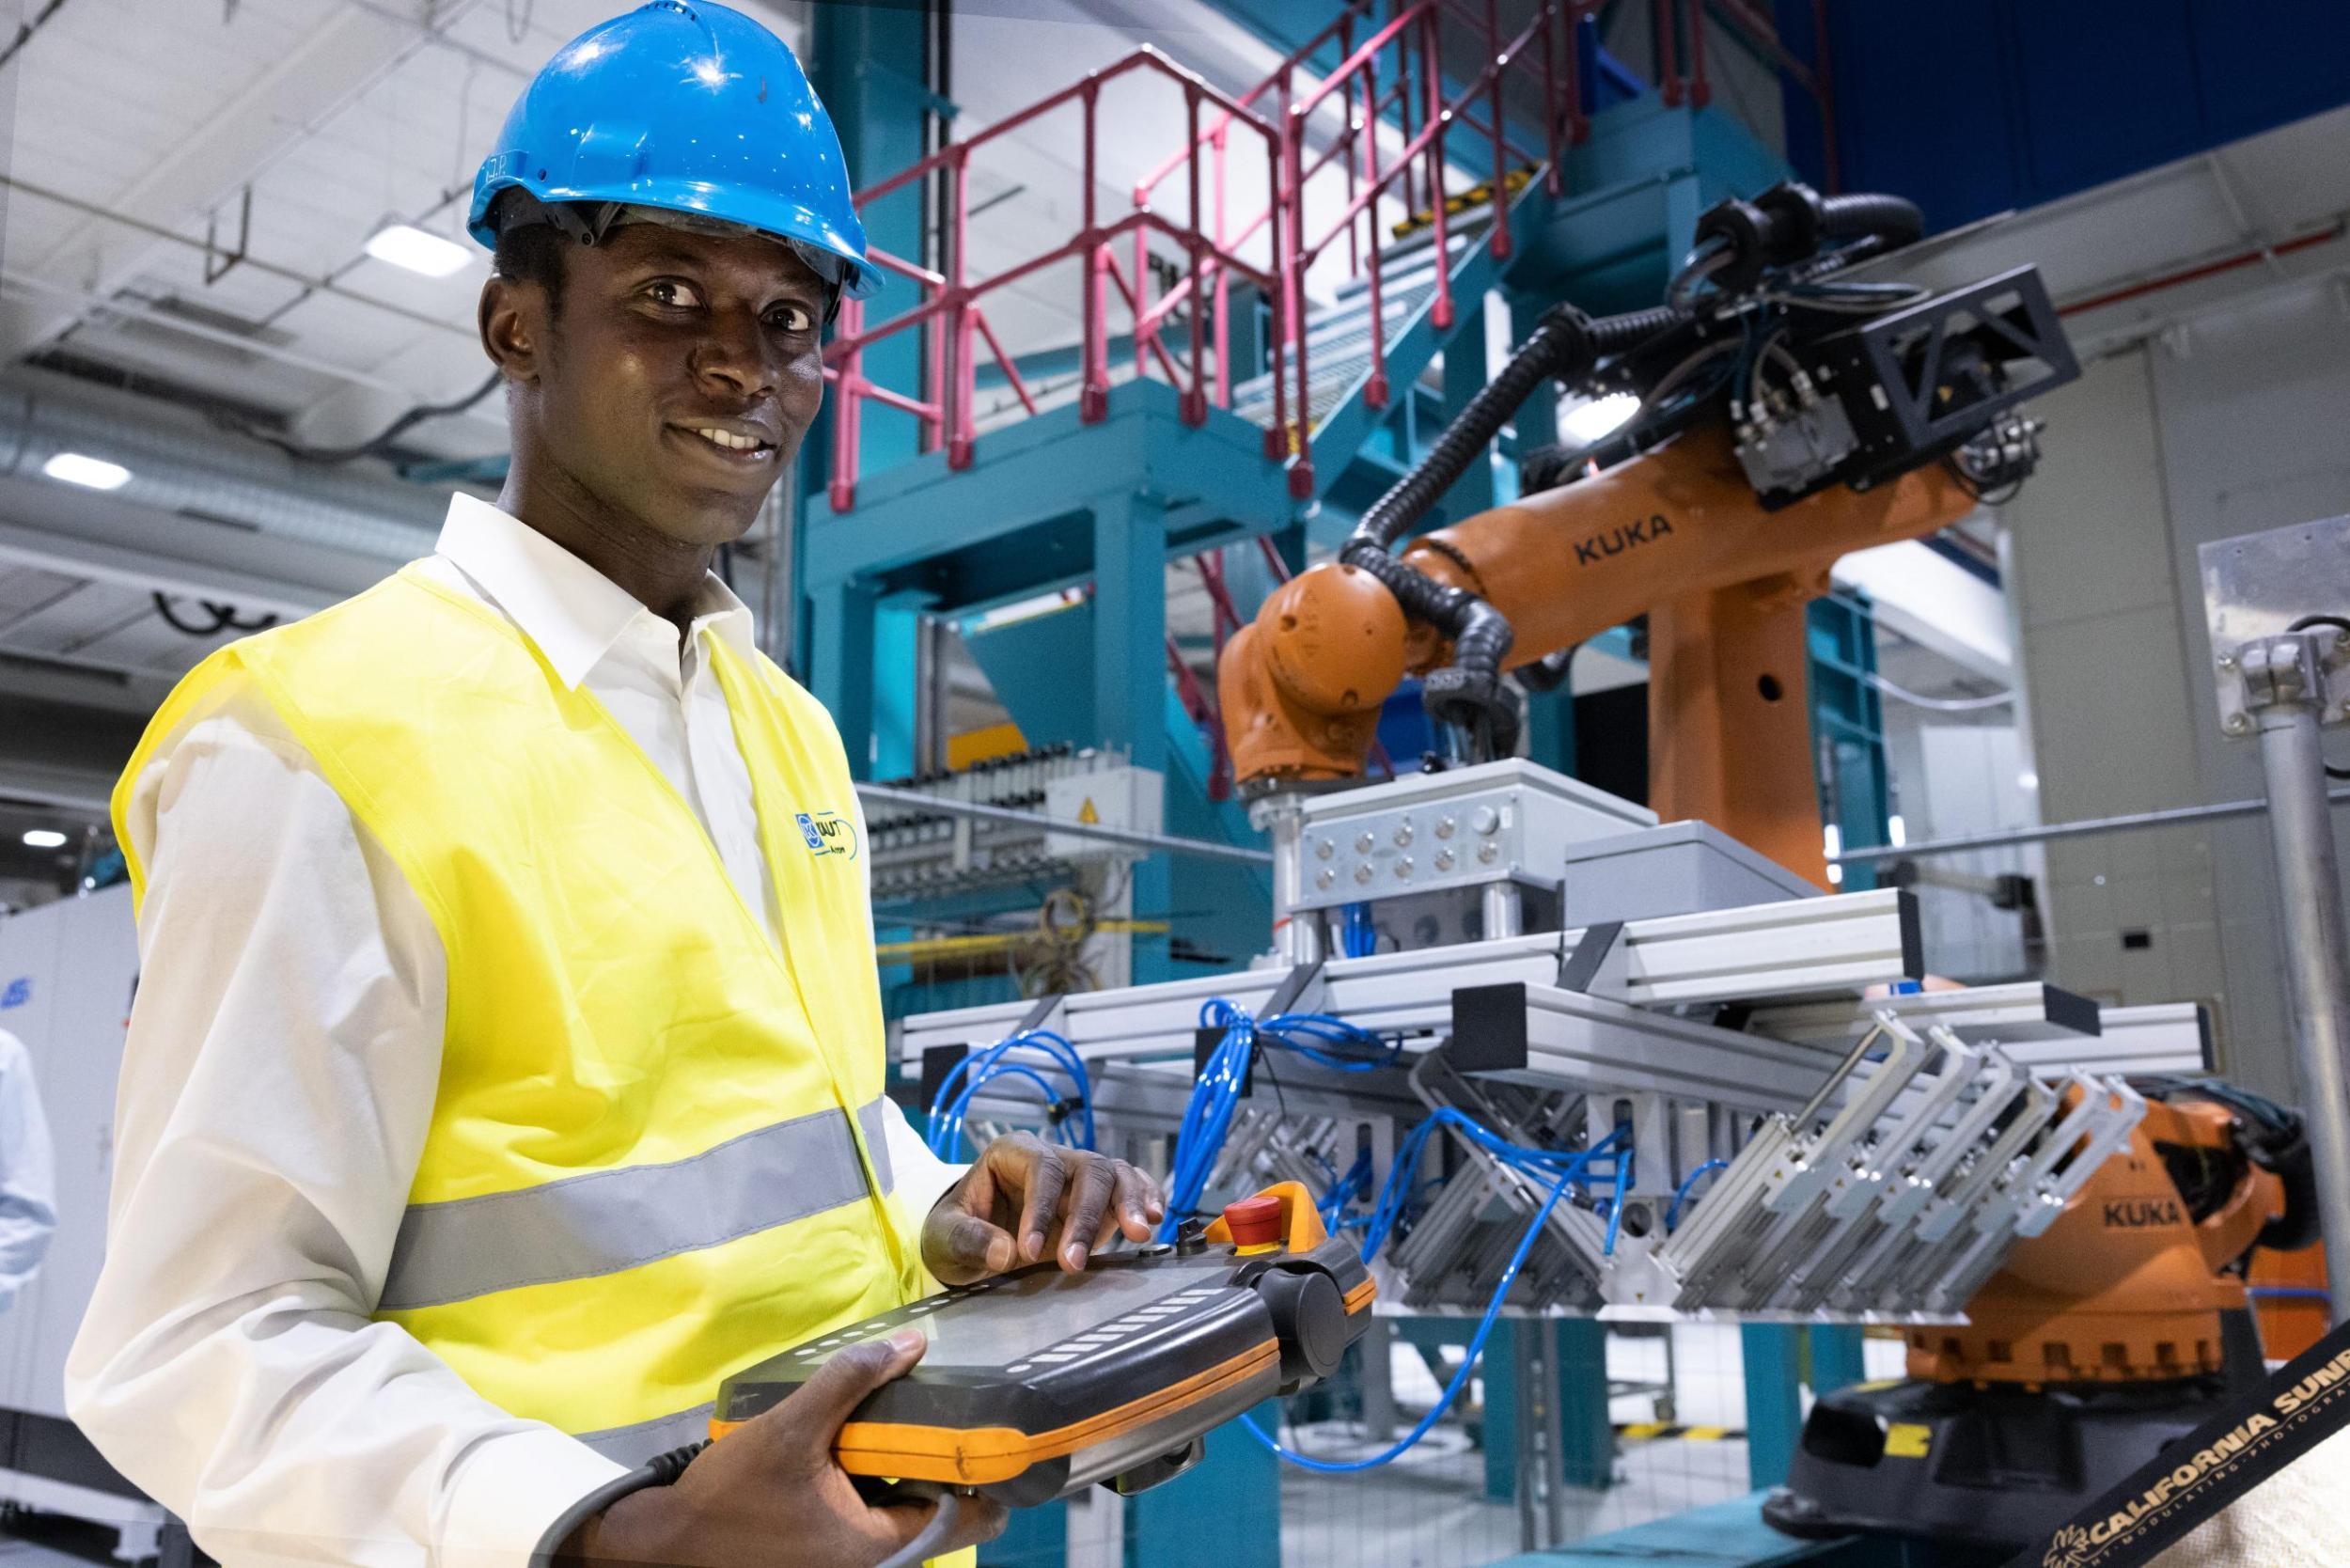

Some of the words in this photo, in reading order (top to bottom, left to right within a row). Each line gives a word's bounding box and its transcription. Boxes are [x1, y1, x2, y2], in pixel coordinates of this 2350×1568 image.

[1574, 514, 1673, 565] KUKA
[2104, 1202, 2180, 1227] KUKA
[2090, 1413, 2278, 1544] CALIFORNIA
